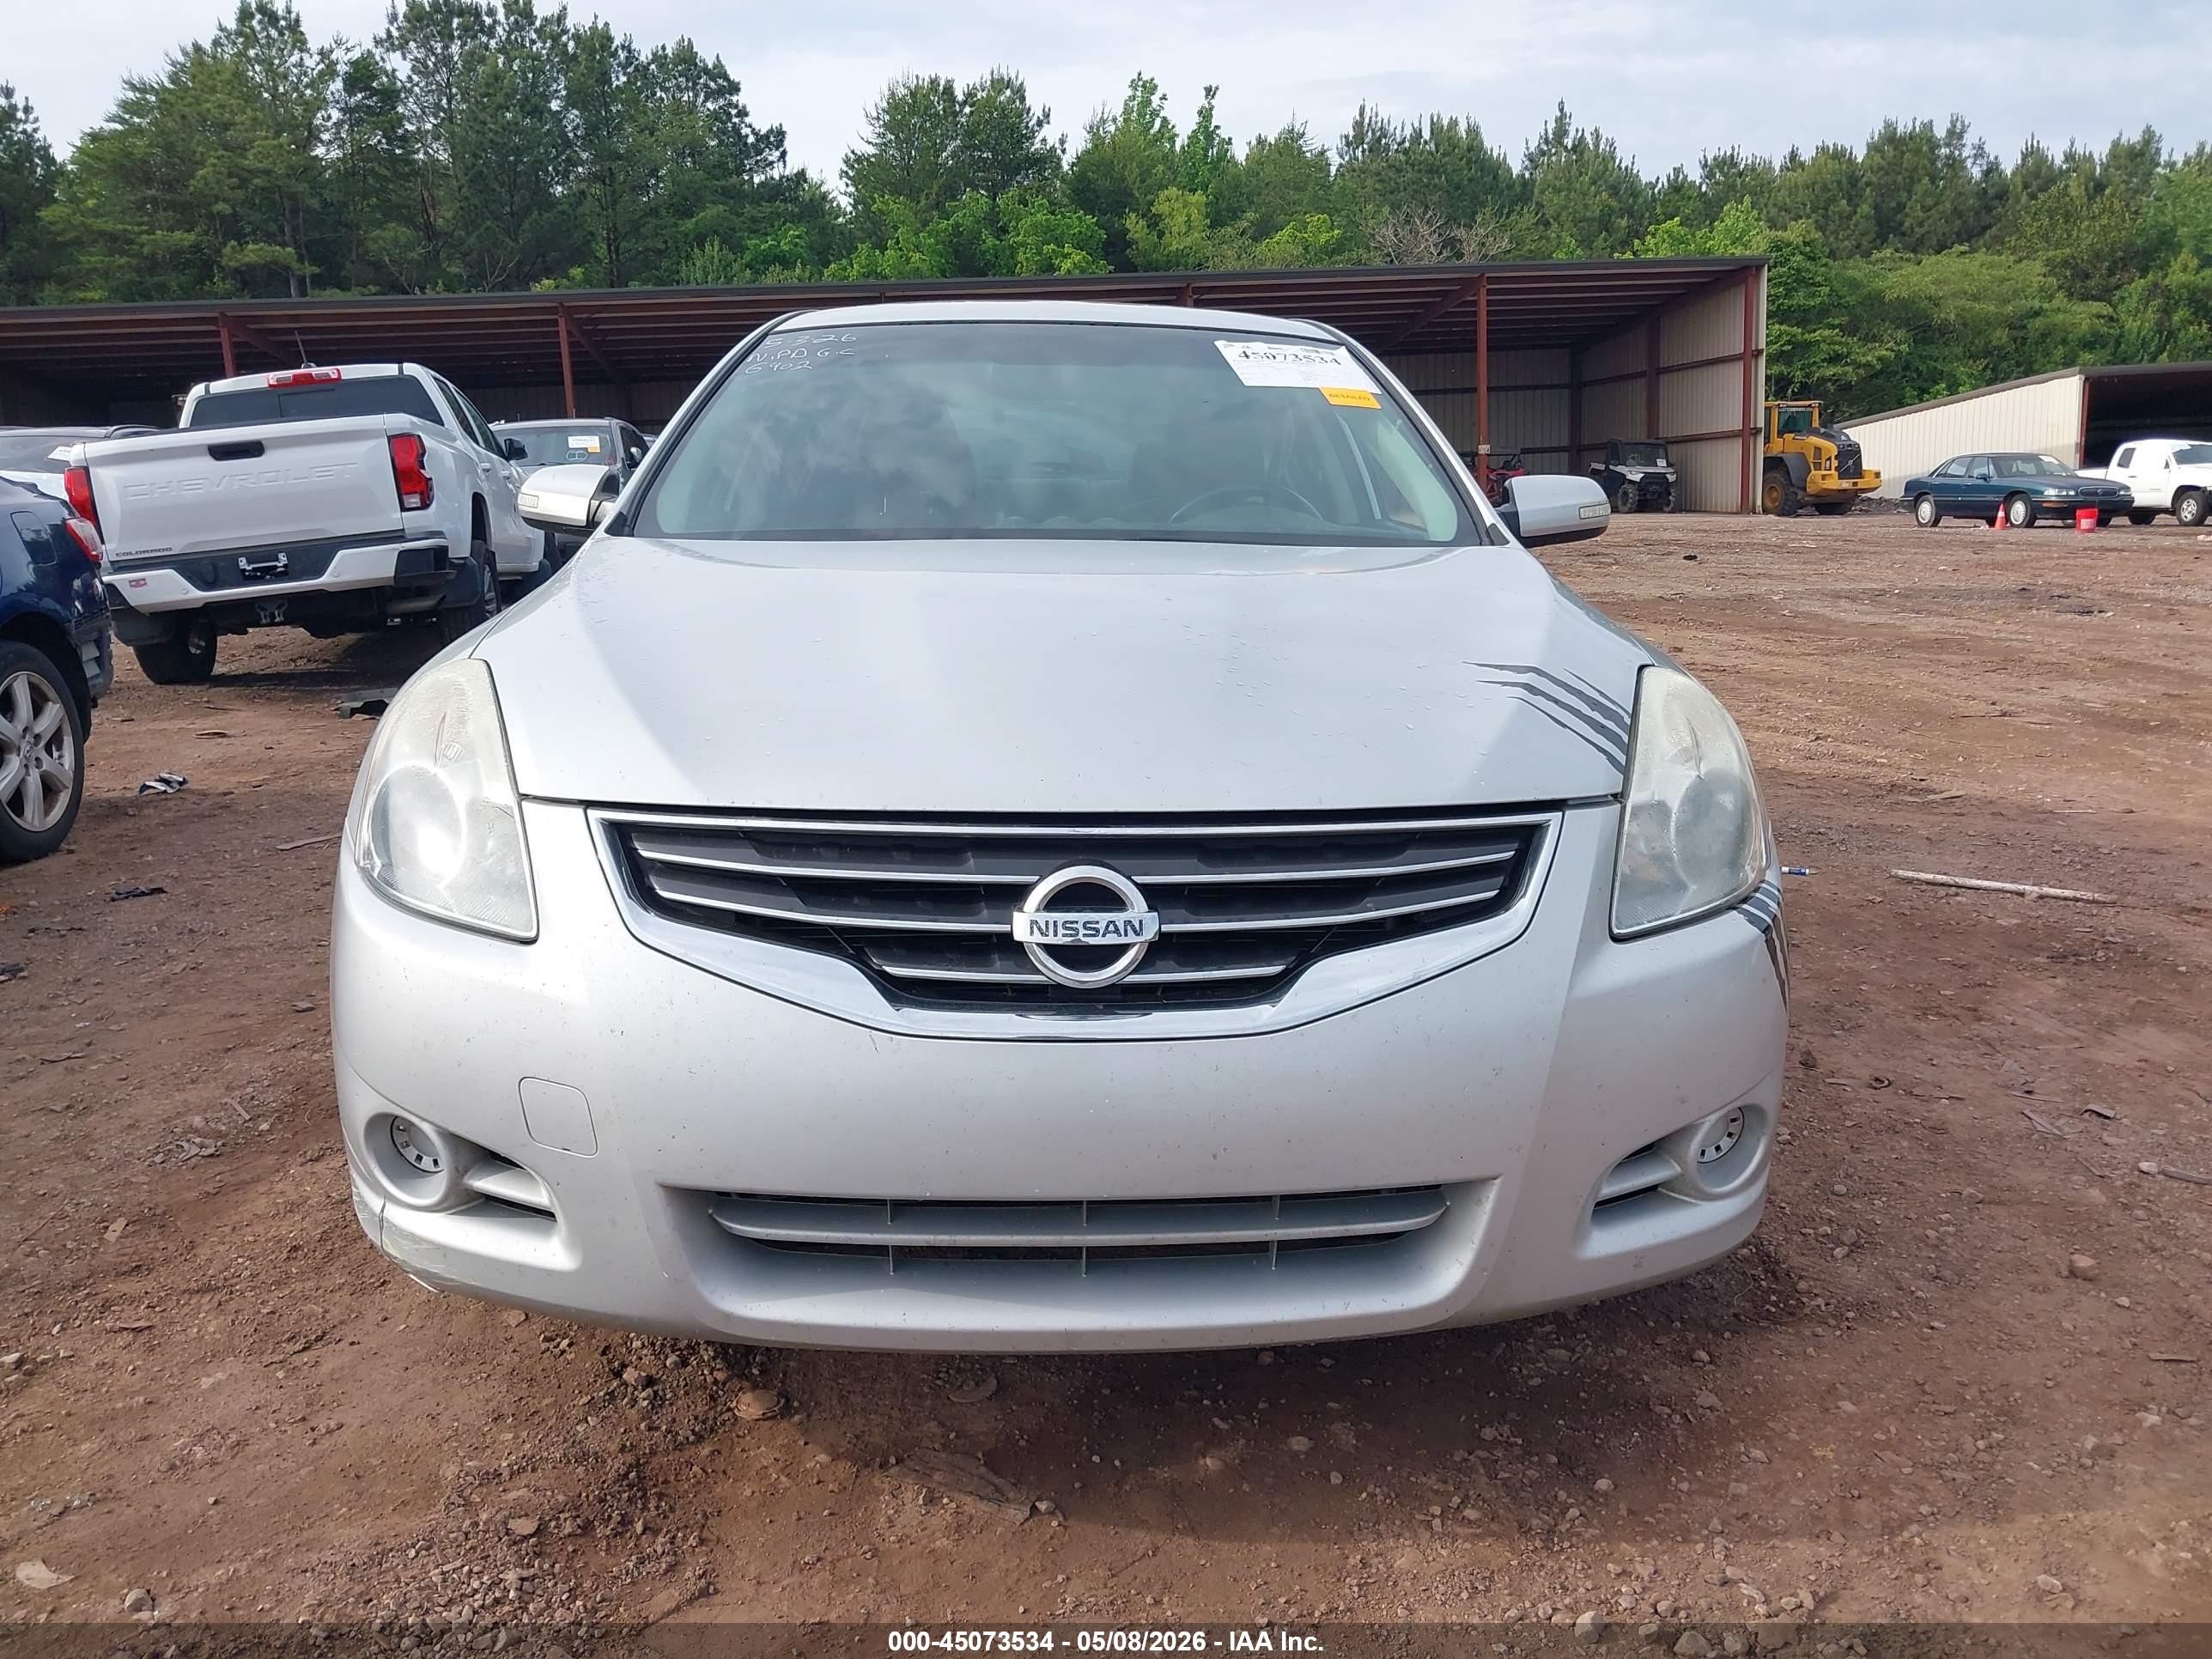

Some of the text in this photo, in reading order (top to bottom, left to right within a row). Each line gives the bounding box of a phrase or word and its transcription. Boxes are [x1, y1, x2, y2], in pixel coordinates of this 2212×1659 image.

[123, 462, 358, 500] CHEVROLET
[115, 546, 173, 557] COLORADO
[1030, 919, 1144, 938] NISSAN
